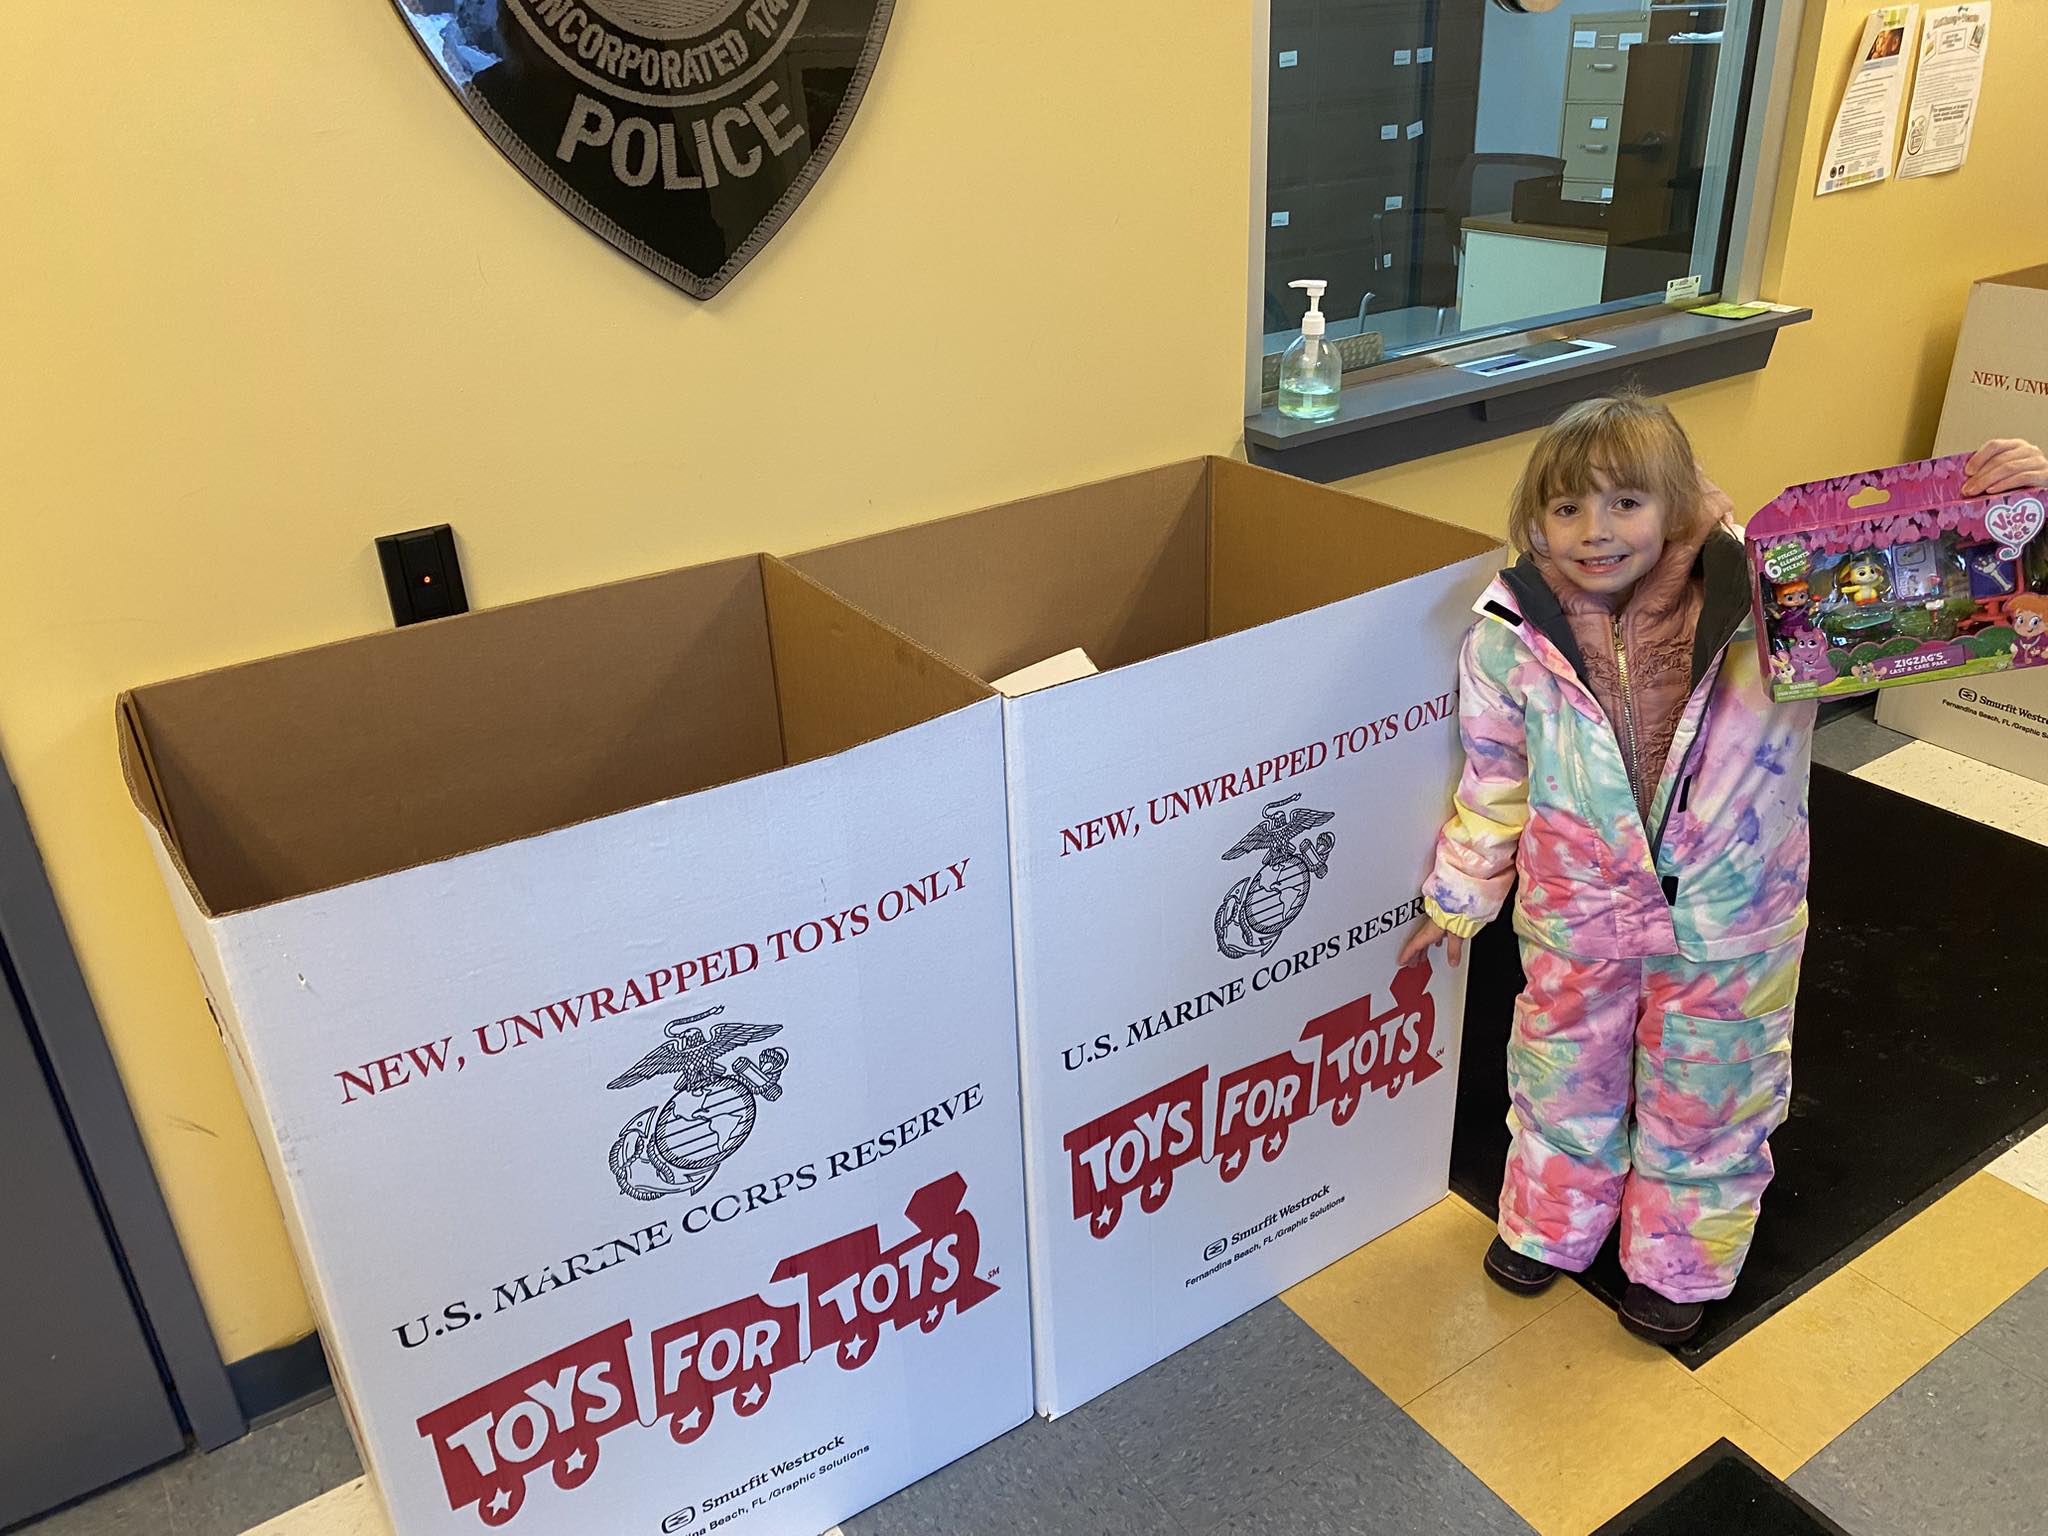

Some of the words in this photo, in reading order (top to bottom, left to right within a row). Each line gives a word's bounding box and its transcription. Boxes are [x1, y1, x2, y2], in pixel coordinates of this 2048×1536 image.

[529, 0, 749, 89] NCORPORATED
[555, 80, 805, 190] POLICE
[1970, 370, 2009, 391] NEW,
[1991, 505, 2037, 531] Vida
[1764, 558, 1782, 578] 6
[1889, 666, 1906, 675] CAST
[1914, 662, 1930, 670] CARE
[1894, 652, 1944, 669] ZIGZAG'S
[1942, 699, 1977, 716] Fernandina
[1978, 710, 2001, 724] Beach,
[1979, 695, 2017, 715] Smurfit
[1059, 806, 1140, 858] NEW,
[1147, 741, 1328, 827] UNWRAPPED
[1333, 713, 1399, 761] TOYS
[334, 1036, 467, 1104] NEW,
[472, 942, 760, 1057] UNWRAPPED
[766, 903, 870, 963] TOYS
[876, 857, 971, 922] ONLY
[1061, 1033, 1119, 1073] U.S.
[1125, 976, 1247, 1049] MARINE
[1251, 935, 1341, 994] CORPS
[1346, 895, 1426, 952] RESER
[1079, 1099, 1194, 1193] TOYS
[1219, 1074, 1301, 1136] FOR
[1326, 1011, 1421, 1084] TOTS
[392, 1300, 483, 1351] U.S.
[492, 1219, 674, 1314] MARINE
[681, 1162, 818, 1234] CORPS
[826, 1082, 984, 1179] RESERVE
[1185, 1257, 1232, 1288] Fernandina
[1234, 1242, 1262, 1262] Beach,
[1263, 1235, 1274, 1246] FL
[1309, 1195, 1346, 1221] Solutions
[1231, 1213, 1279, 1246] Smurfit
[1279, 1184, 1331, 1220] Westrock
[446, 1359, 622, 1478] TOYS
[663, 1317, 781, 1396] FOR
[818, 1231, 960, 1325] TOTS
[702, 1472, 769, 1513] Smurfit
[770, 1434, 846, 1478] Westrock
[709, 1507, 750, 1531] Beach,
[751, 1497, 767, 1510] FL
[818, 1444, 870, 1476] Solutions
